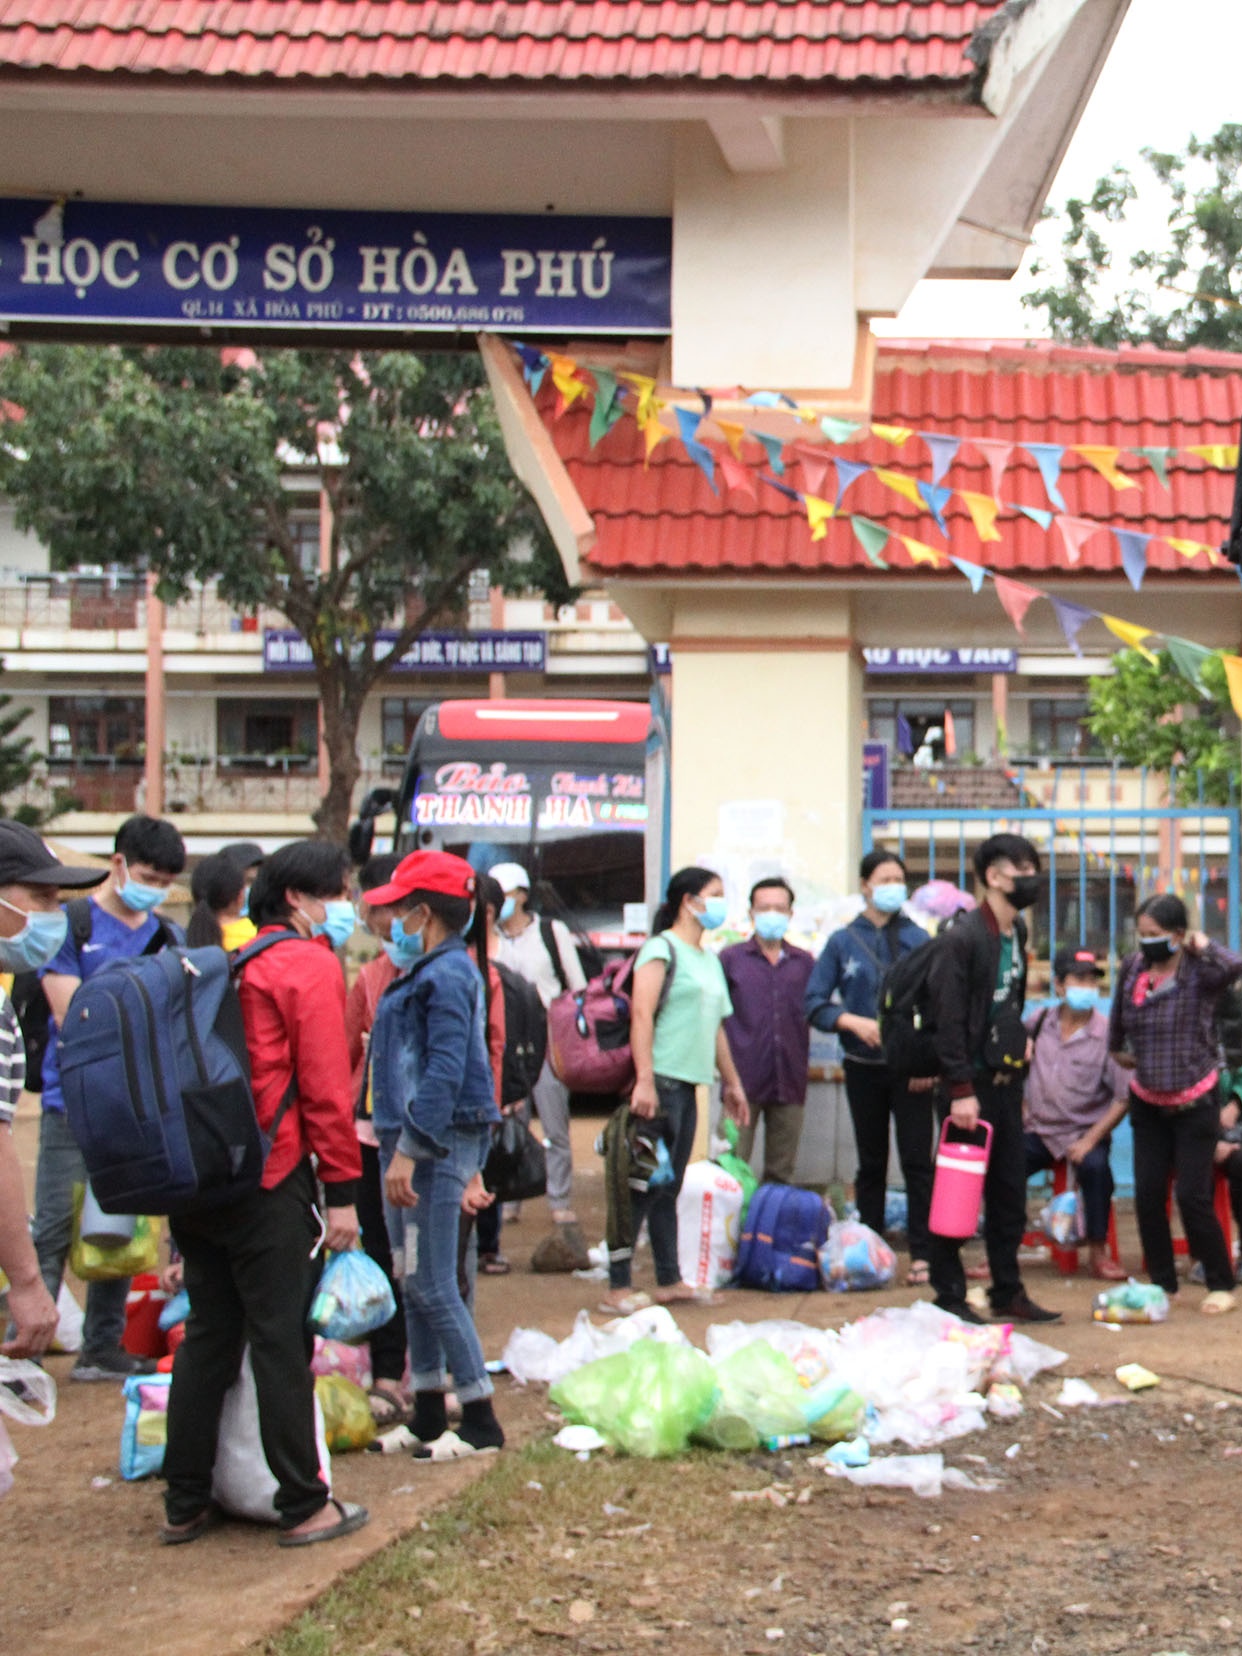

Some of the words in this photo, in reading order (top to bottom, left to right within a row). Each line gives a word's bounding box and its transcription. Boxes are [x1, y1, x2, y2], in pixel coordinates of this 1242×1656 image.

[20, 235, 140, 299] HỌC
[163, 235, 240, 291] CƠ
[263, 225, 335, 293] SỞ
[358, 230, 478, 296] HÒA
[500, 236, 614, 299] PHÚ
[416, 794, 531, 825] THANH
